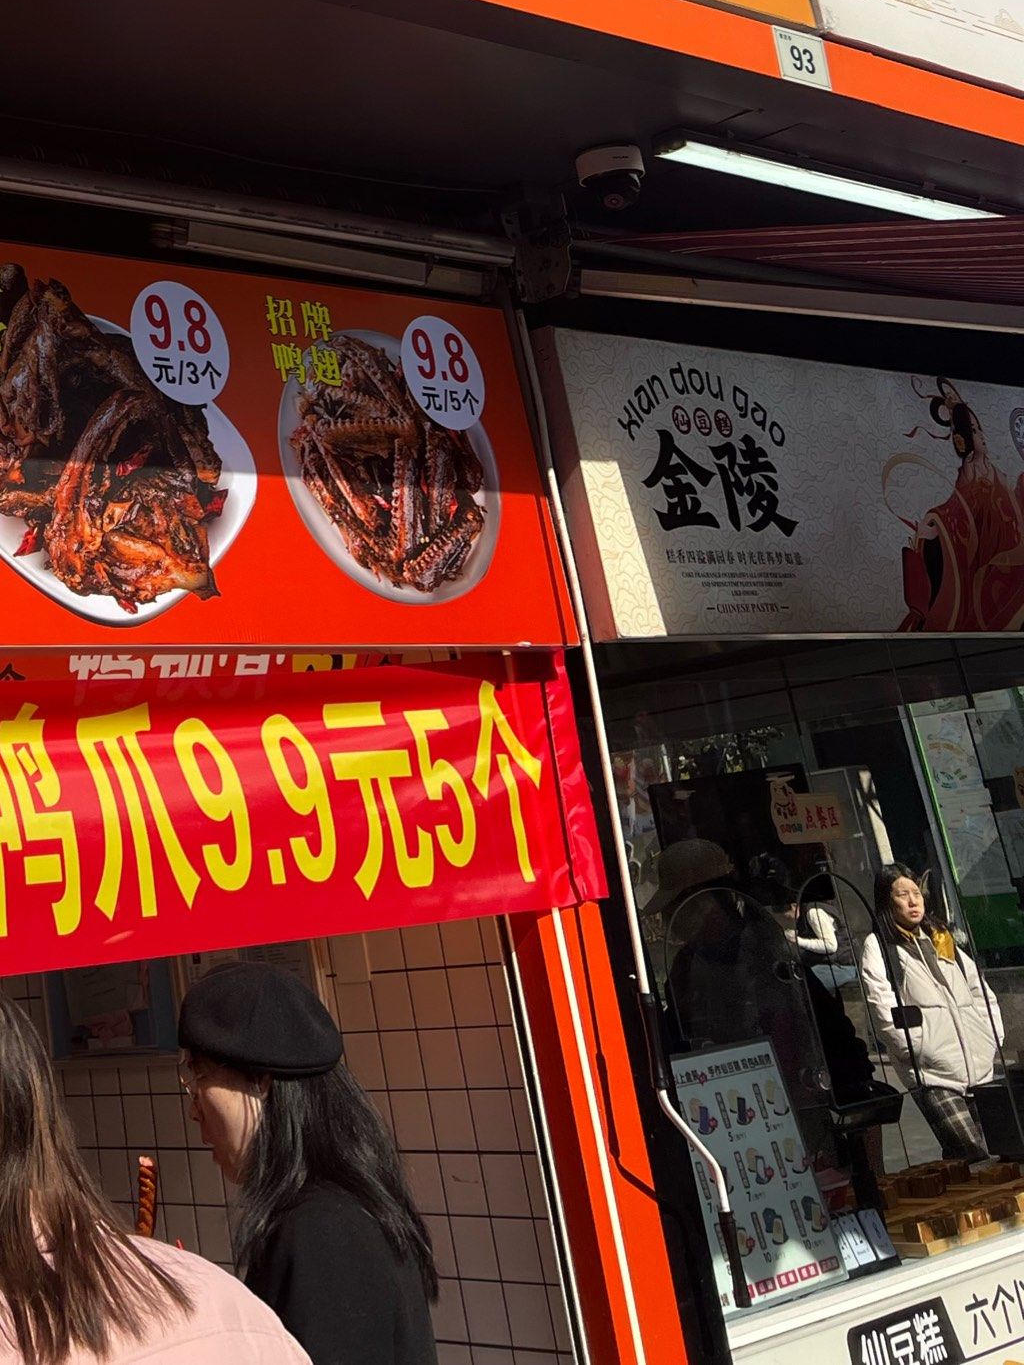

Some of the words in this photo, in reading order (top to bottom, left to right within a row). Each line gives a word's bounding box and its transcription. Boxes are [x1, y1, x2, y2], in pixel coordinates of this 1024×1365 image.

[790, 45, 816, 74] 93
[144, 294, 212, 355] 9.8
[266, 296, 333, 341] 招牌
[153, 357, 222, 389] 元/3个
[271, 342, 343, 387] 鸭翅
[411, 328, 469, 383] 9.8
[422, 385, 480, 416] 元/5个
[617, 373, 669, 441] xian
[672, 362, 724, 402] dou
[732, 385, 786, 447] gao
[641, 428, 799, 537] 金陵
